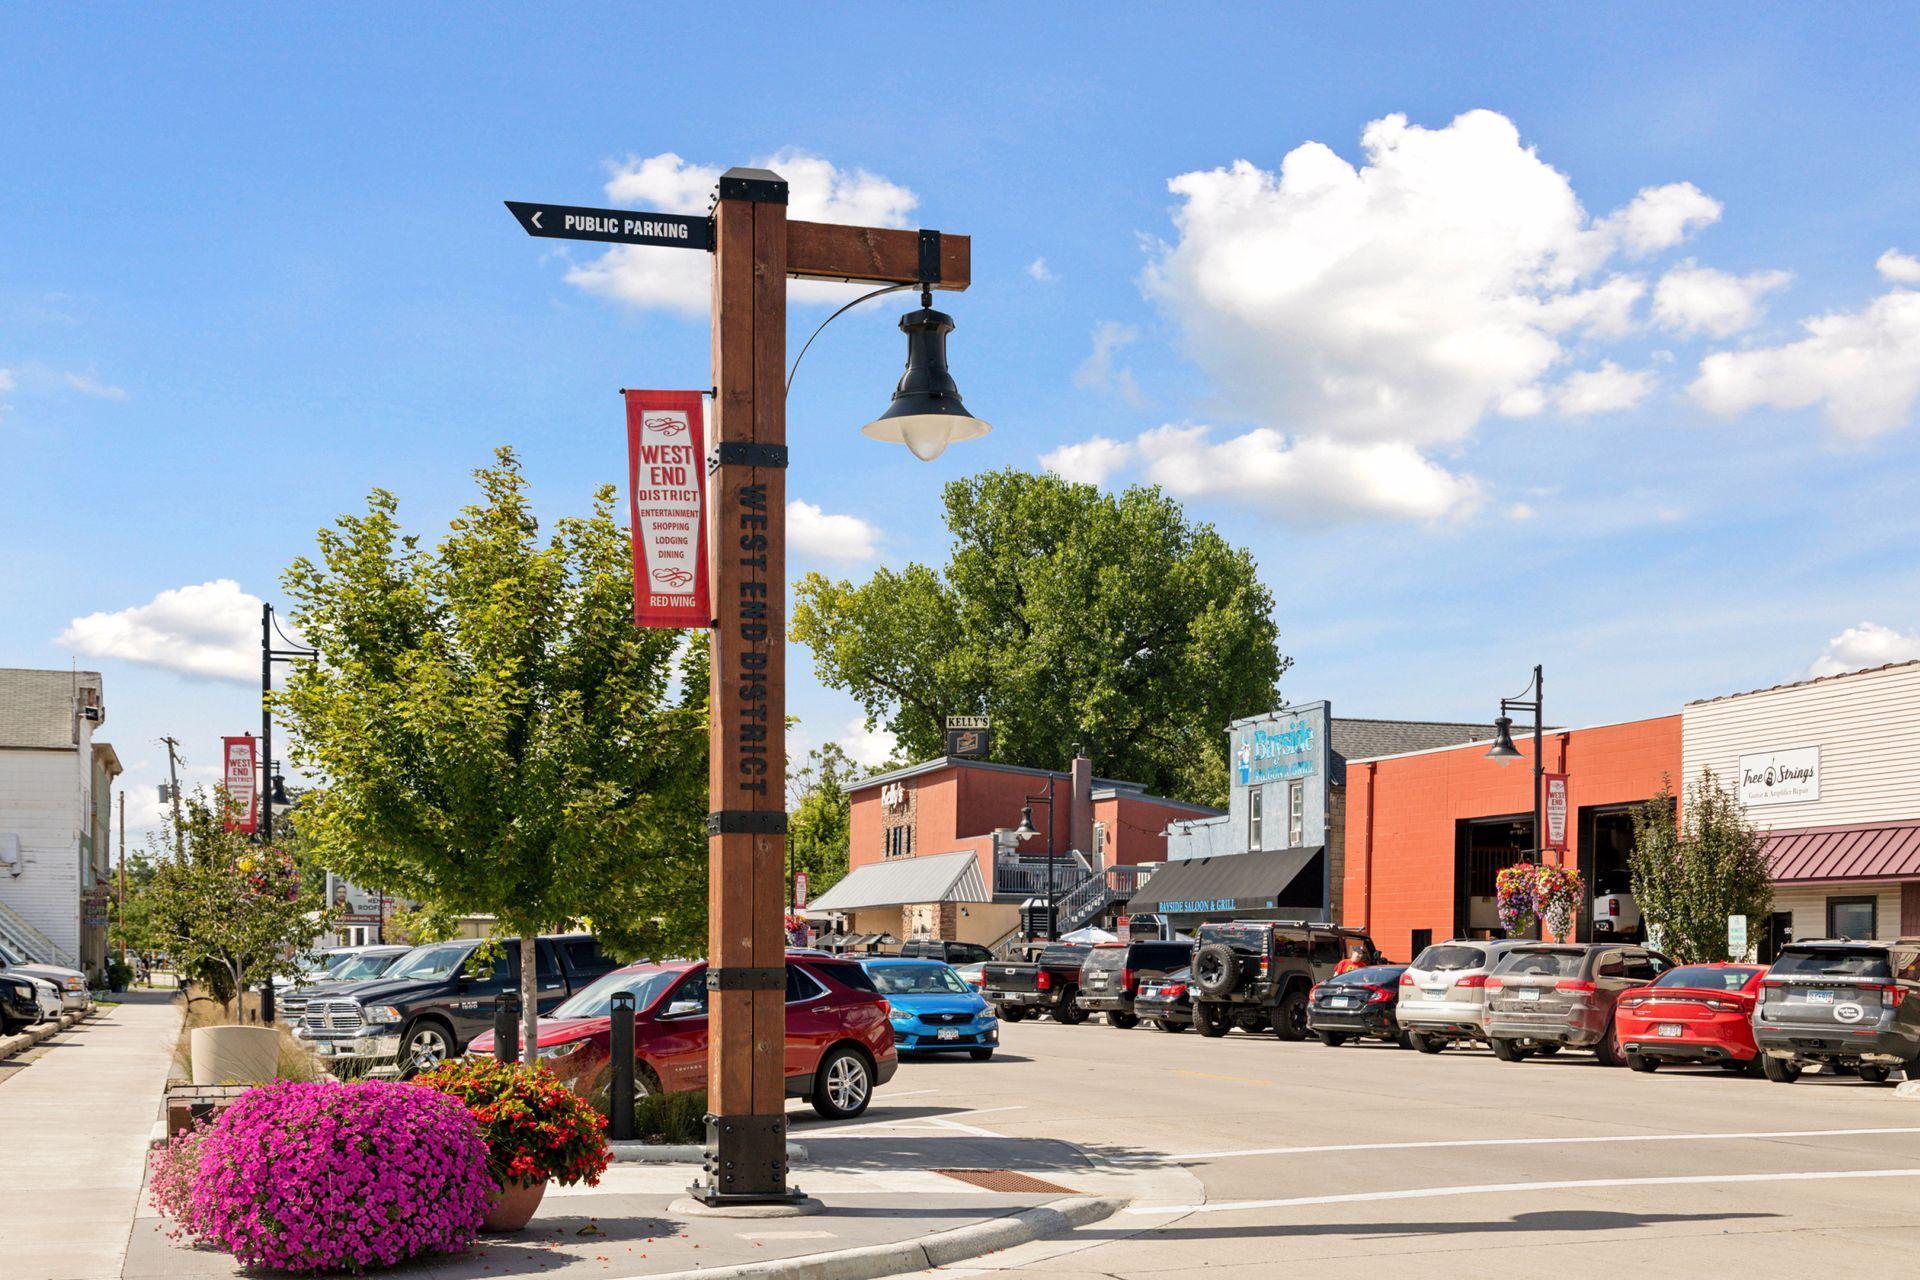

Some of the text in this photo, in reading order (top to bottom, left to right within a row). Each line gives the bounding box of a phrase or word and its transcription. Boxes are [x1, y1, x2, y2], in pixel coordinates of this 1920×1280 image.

[565, 215, 688, 239] PUBLIC PARKING
[641, 445, 693, 464] WEST
[650, 467, 687, 486] END
[640, 490, 699, 502] DISTRICT
[641, 509, 698, 518] ENTERTAINMENT
[653, 522, 689, 531] SHOPPING
[655, 536, 688, 545] LODGING
[658, 551, 684, 559] DINING
[650, 596, 696, 608] RED WING
[739, 484, 767, 796] WEST END DISTRICT
[948, 717, 988, 727] KELLY'S
[1254, 720, 1314, 766] Bayside
[229, 759, 251, 767] WEST
[232, 768, 249, 776] END
[1743, 765, 1814, 787] Tree Strings
[1160, 899, 1235, 912] BAYSIDE SALOON & GRILL
